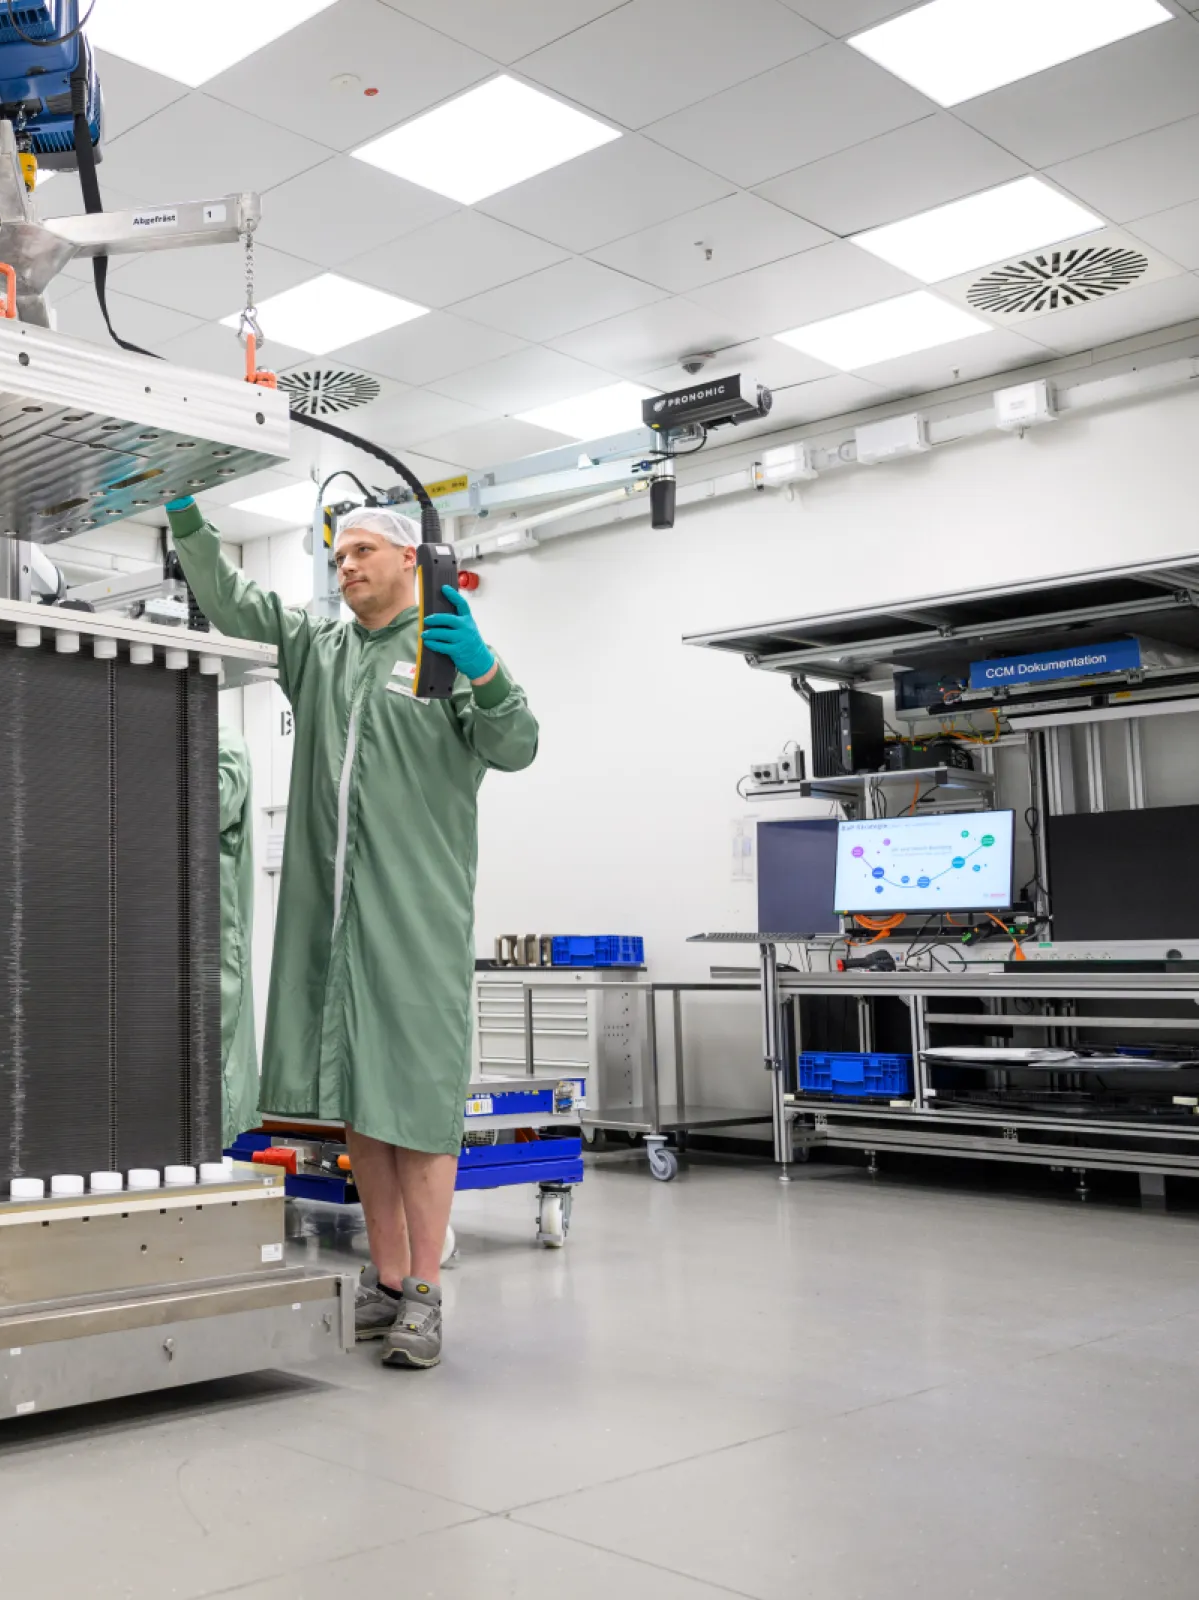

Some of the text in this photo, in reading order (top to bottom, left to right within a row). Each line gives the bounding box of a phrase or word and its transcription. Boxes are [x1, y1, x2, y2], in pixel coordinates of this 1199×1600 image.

[132, 210, 212, 226] Abgefräst 1
[667, 384, 726, 407] PRONOMIC
[985, 654, 1107, 679] CCM Dokumentation
